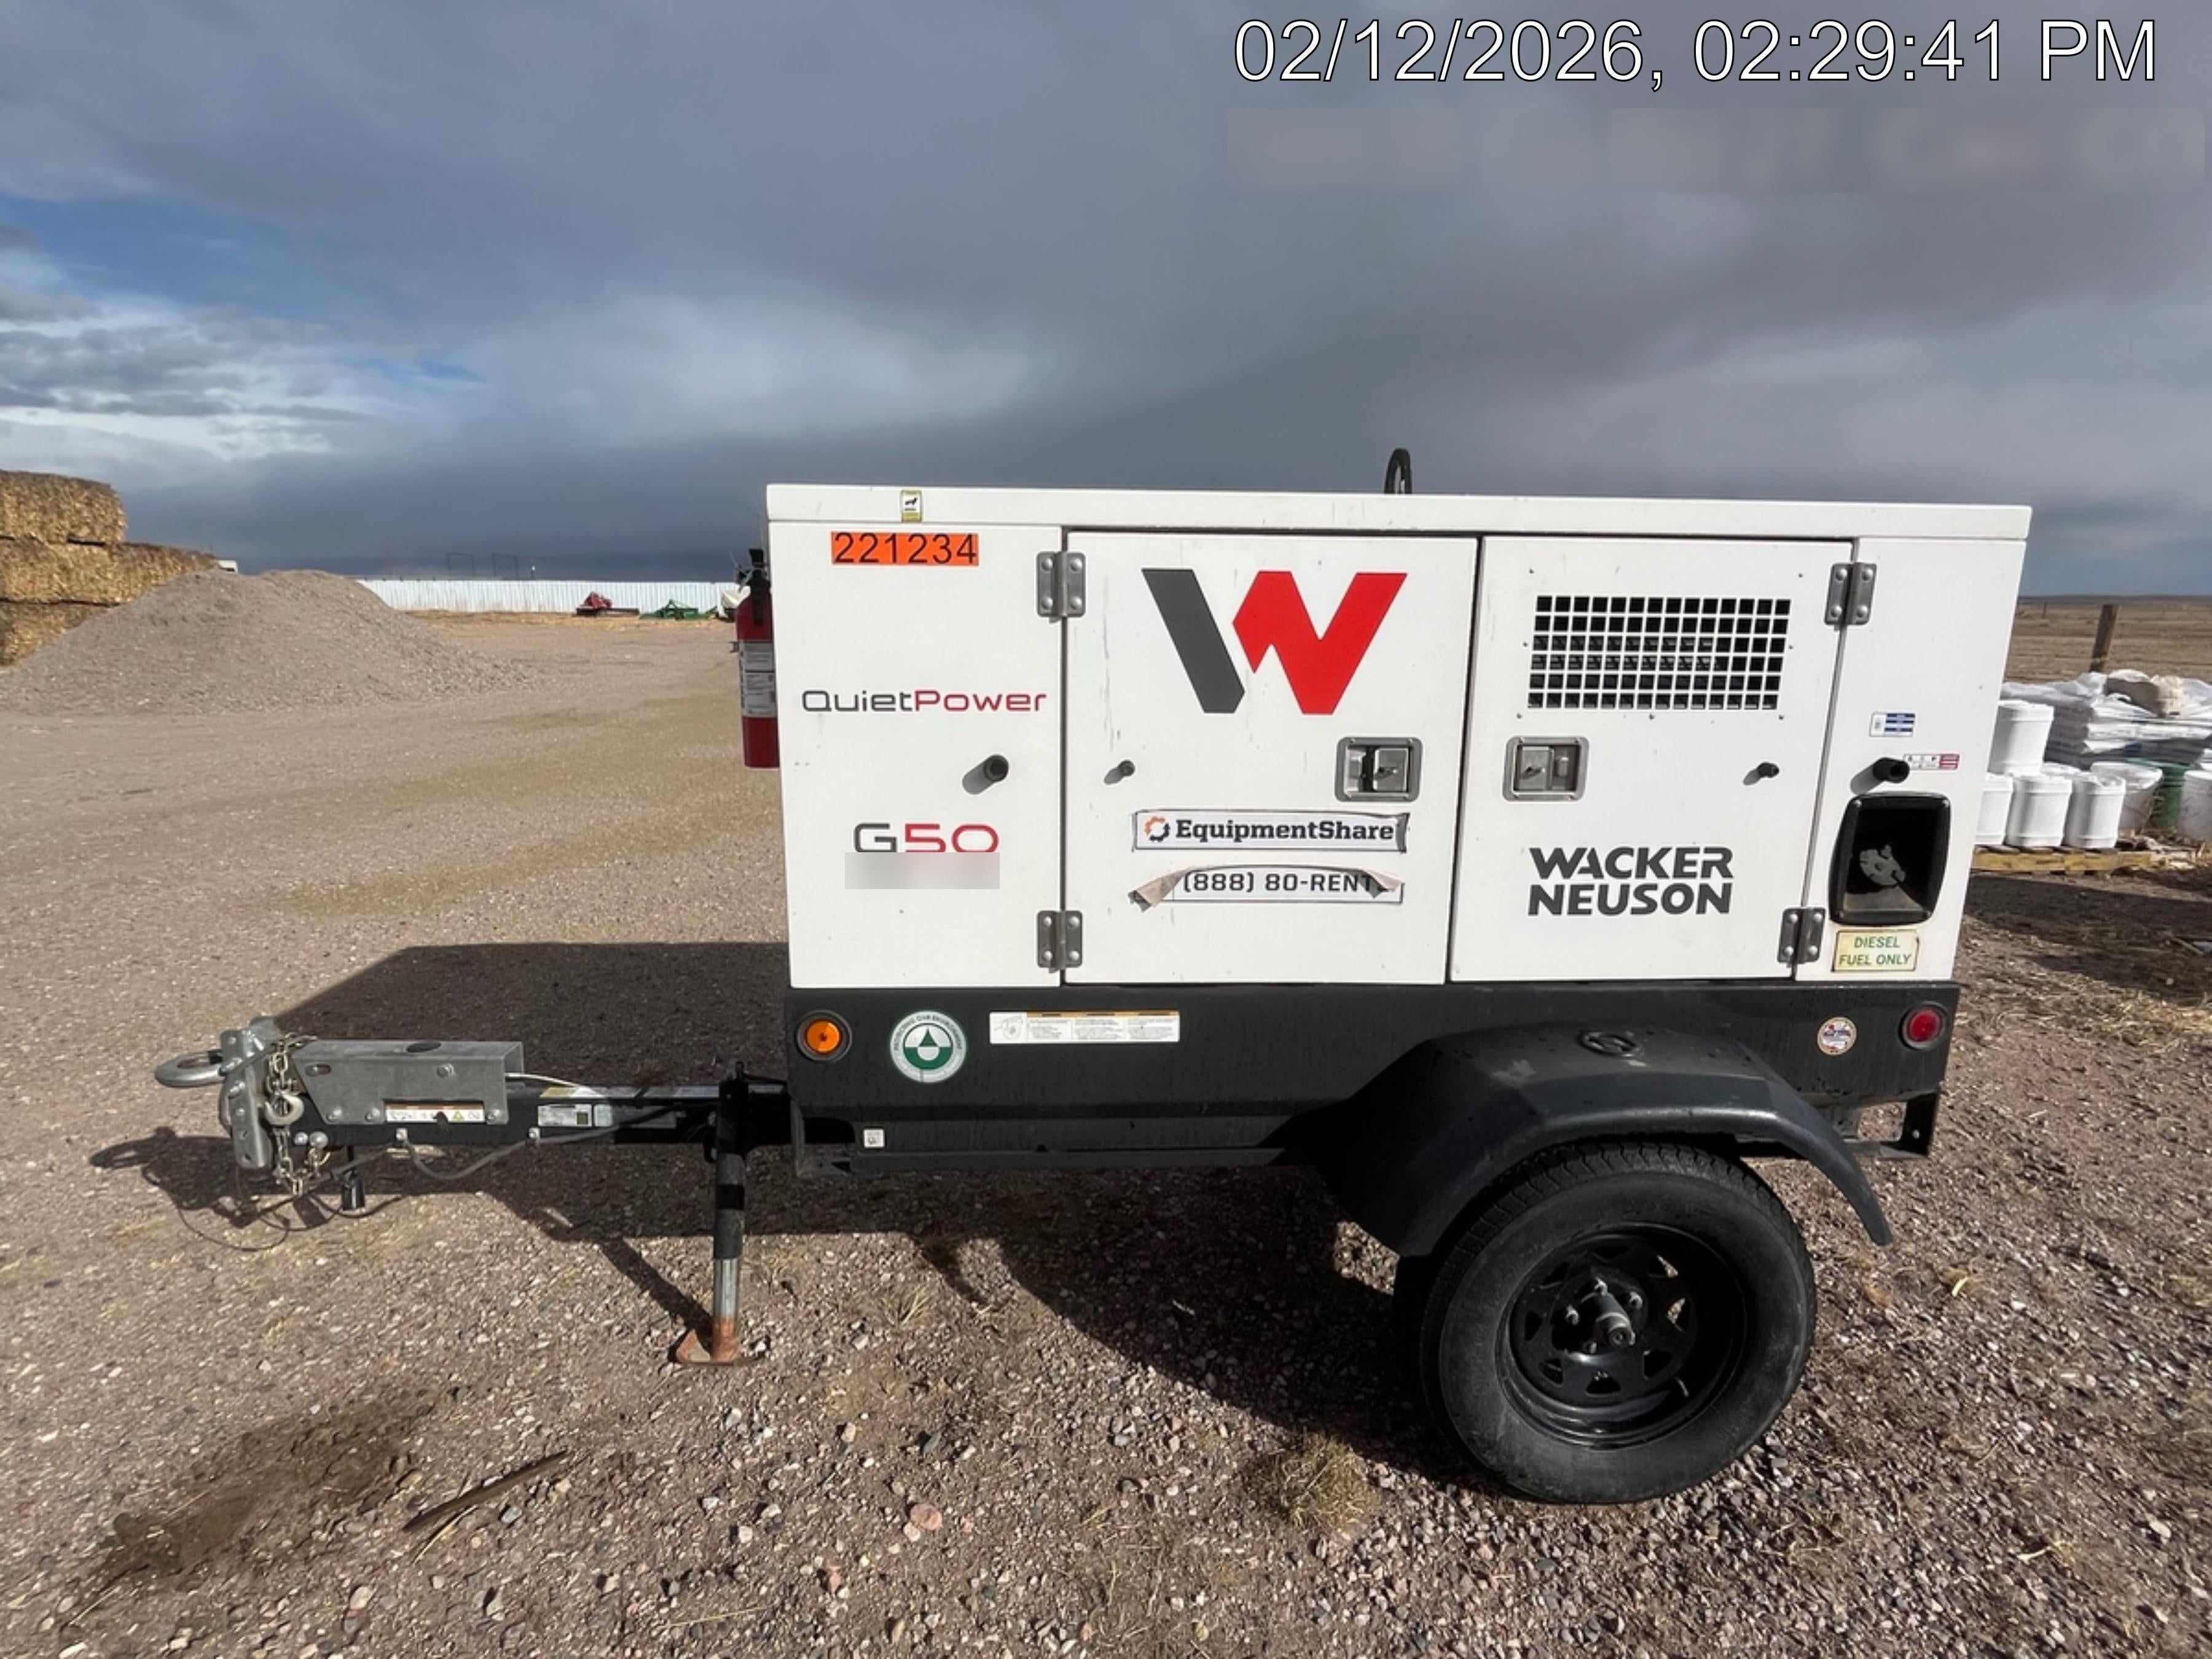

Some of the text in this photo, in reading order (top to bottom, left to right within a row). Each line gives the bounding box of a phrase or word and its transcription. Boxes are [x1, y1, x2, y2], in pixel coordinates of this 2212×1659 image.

[834, 533, 977, 565] 221234
[802, 690, 1047, 713] QuietPower
[853, 823, 1000, 853] G50
[1176, 820, 1394, 843] EquipmentShare
[1529, 847, 1734, 880] WACKER
[1184, 873, 1254, 893] (888)
[1528, 883, 1734, 917] NEUSON
[1854, 936, 1900, 949] DIESEL
[1839, 954, 1912, 965] FUEL ONLY
